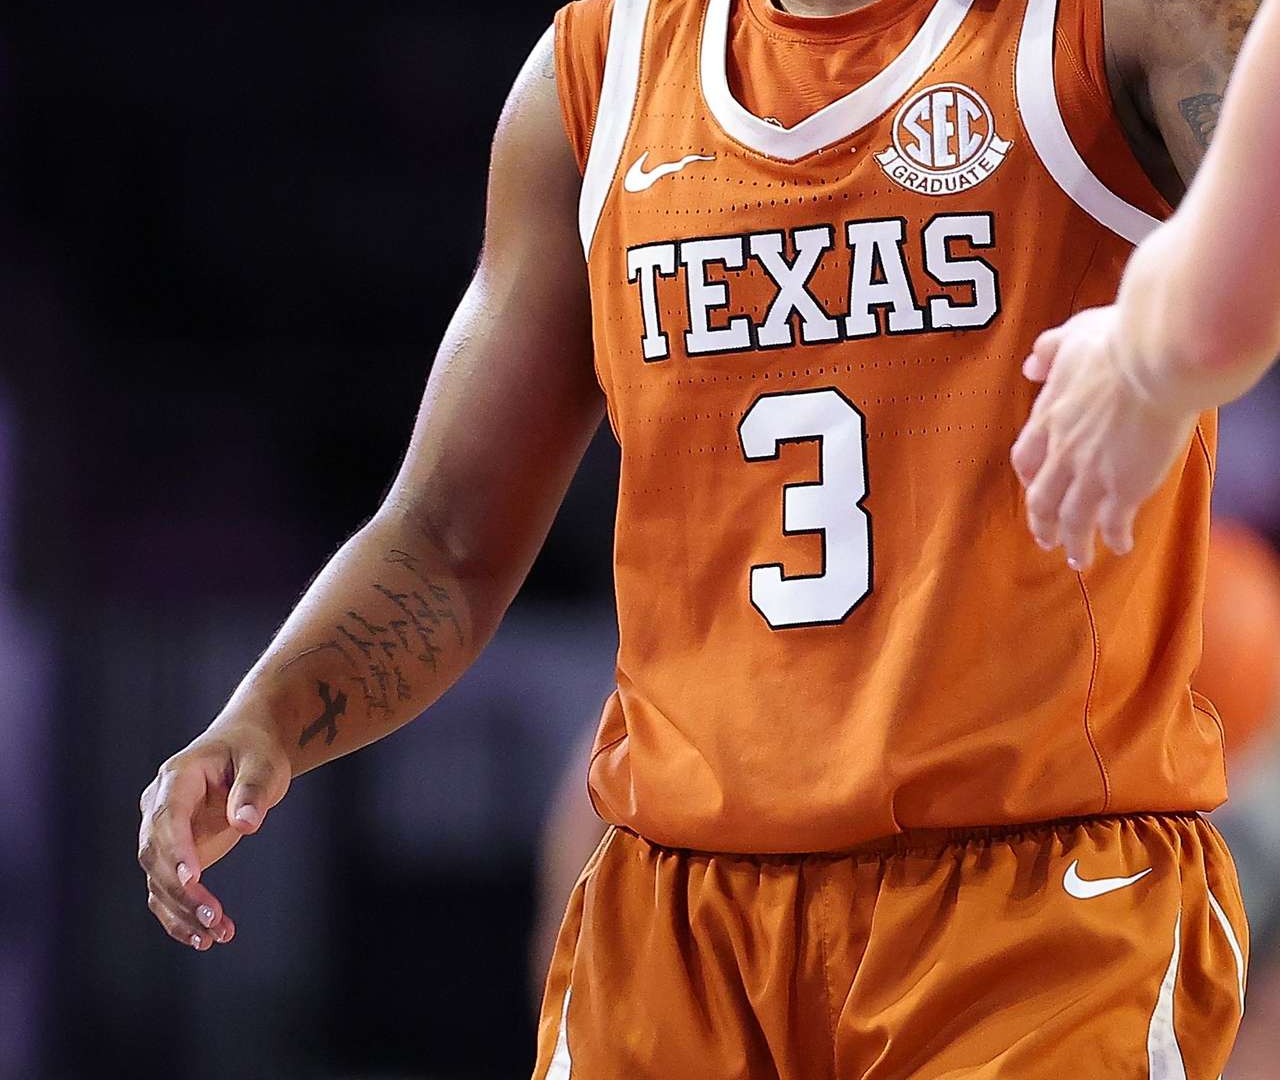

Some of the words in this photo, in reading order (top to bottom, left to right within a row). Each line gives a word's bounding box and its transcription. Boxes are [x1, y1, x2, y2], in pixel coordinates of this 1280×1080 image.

[892, 157, 995, 193] GRADUATE
[902, 91, 984, 167] SEC
[627, 212, 1001, 362] TEXAS
[738, 387, 873, 630] 3
